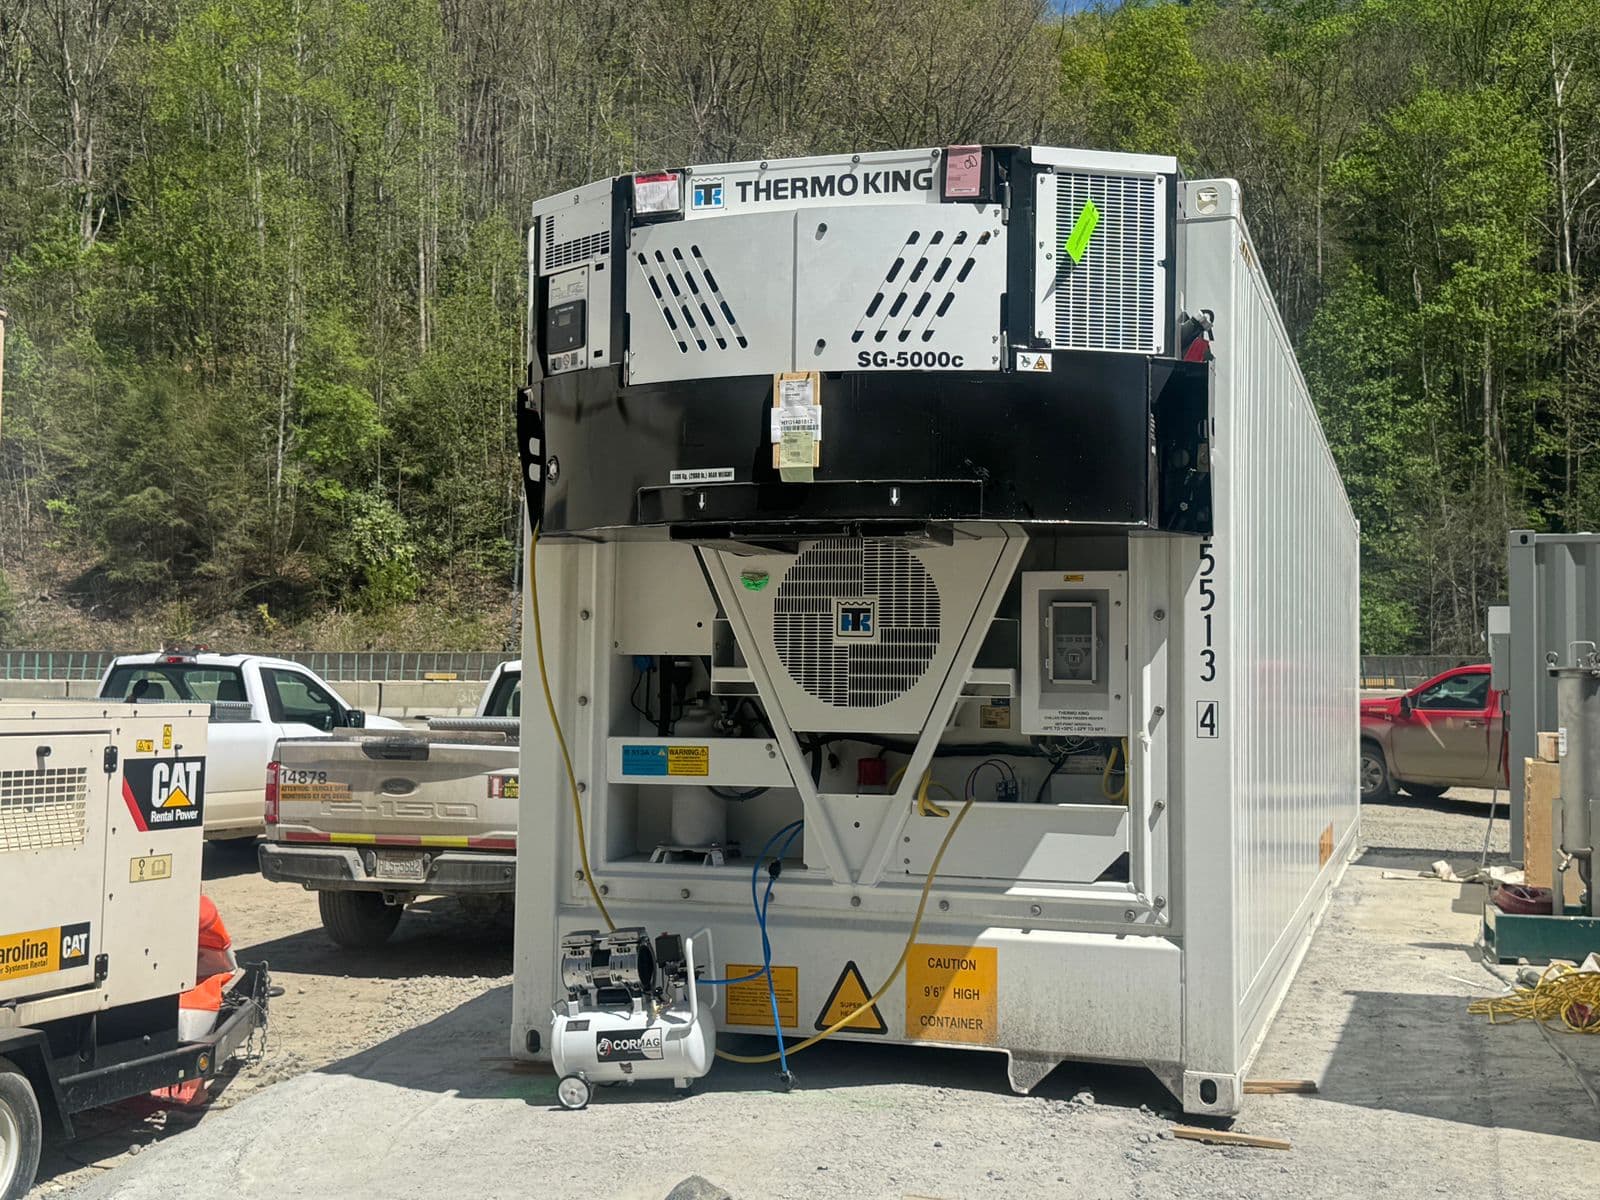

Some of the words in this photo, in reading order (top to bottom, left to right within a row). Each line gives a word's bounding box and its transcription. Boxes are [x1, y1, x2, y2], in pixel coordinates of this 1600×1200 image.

[735, 173, 858, 203] THERMO
[863, 168, 933, 195] KING
[857, 351, 964, 368] SG-5000c
[1199, 536, 1216, 681] 5513
[1200, 703, 1215, 736] 4
[152, 762, 201, 808] CAT
[281, 770, 327, 785] 14878
[150, 809, 174, 823] Rental
[175, 808, 199, 821] Power
[62, 933, 88, 959] CAT
[5, 964, 29, 974] Systems
[30, 960, 48, 969] Rental
[927, 957, 976, 971] CAUTION
[953, 987, 980, 1000] HIGH
[920, 1015, 983, 1029] CONTAINER
[613, 1037, 660, 1051] CORMAG
